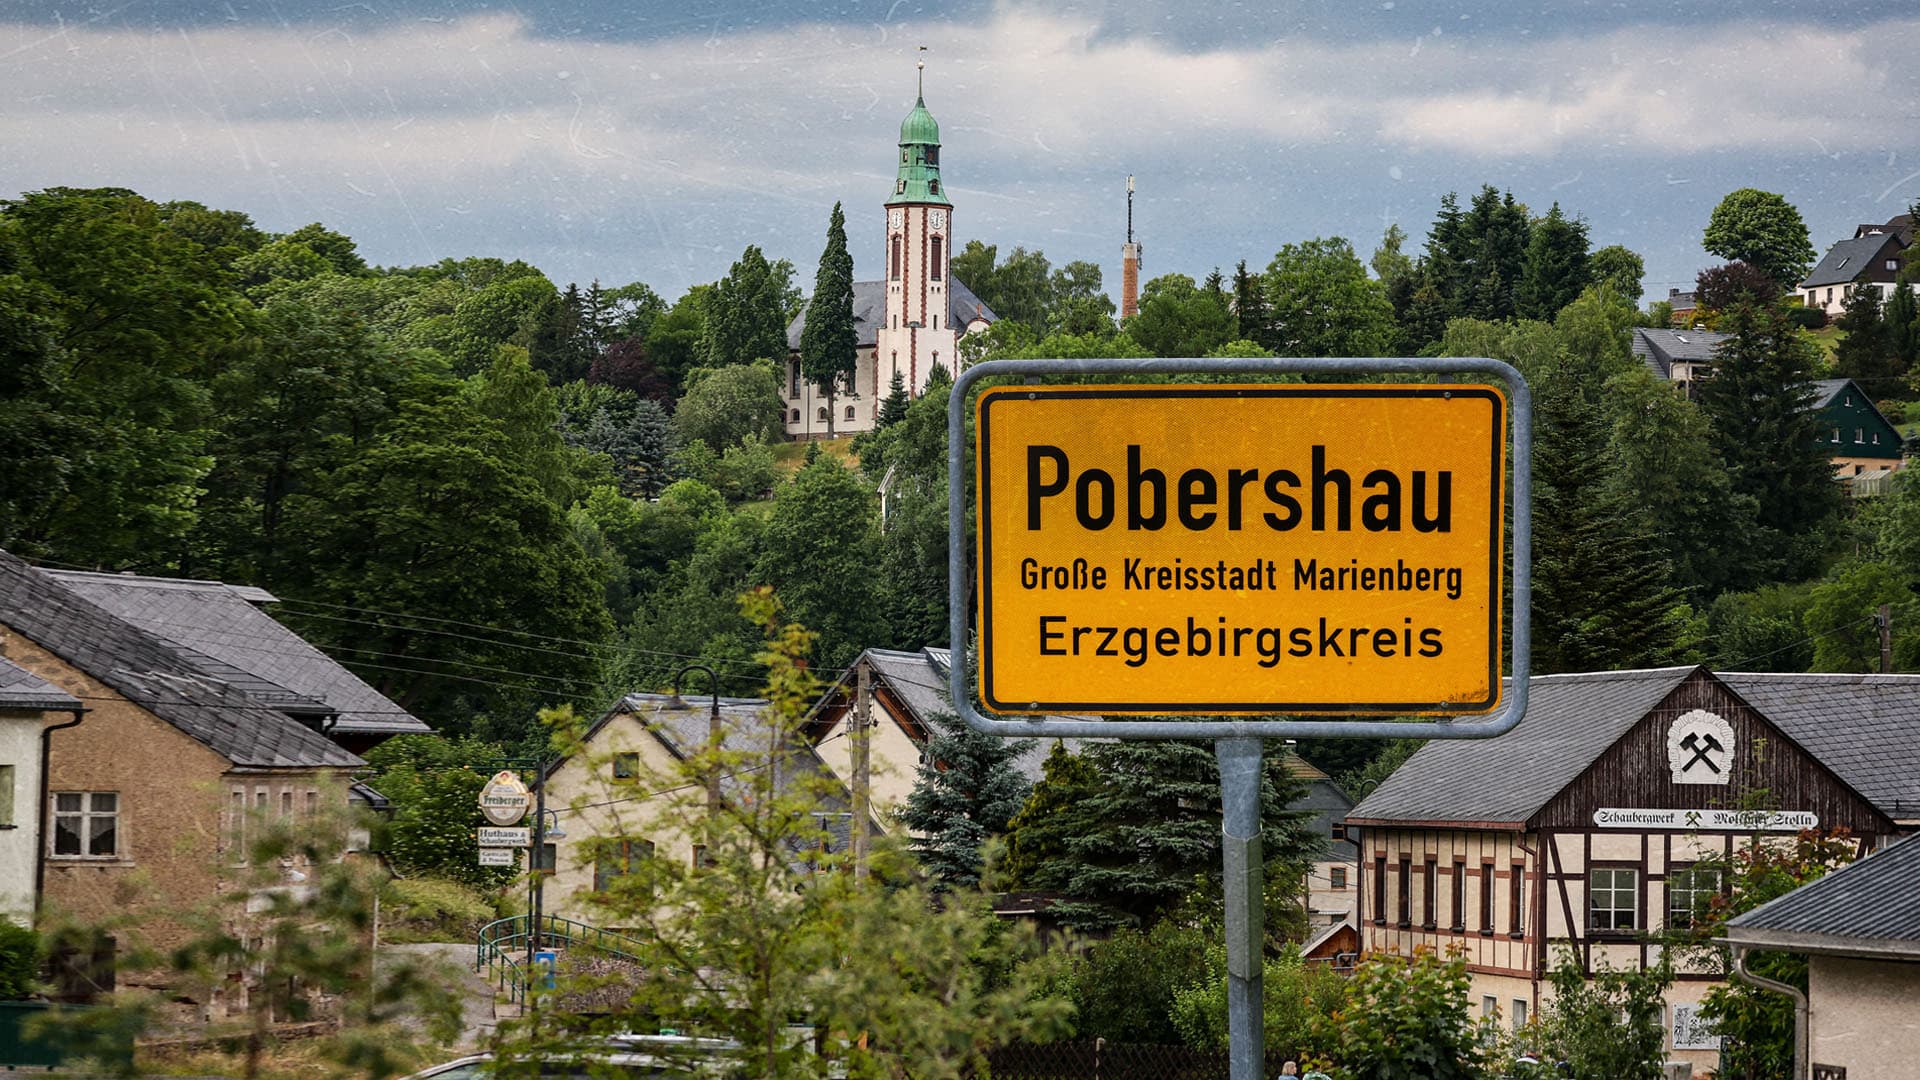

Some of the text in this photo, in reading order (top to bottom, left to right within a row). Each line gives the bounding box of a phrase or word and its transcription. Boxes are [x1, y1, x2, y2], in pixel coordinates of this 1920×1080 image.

[1026, 444, 1453, 533] Pobershau
[1020, 557, 1463, 600] Große Kreisstadt Marienberg
[1039, 615, 1444, 668] Erzgebirgskreis
[484, 795, 524, 806] Freiberger
[480, 829, 518, 837] Huthaus
[1599, 811, 1675, 825] Schaubergwerk
[1773, 813, 1813, 826] Stolln
